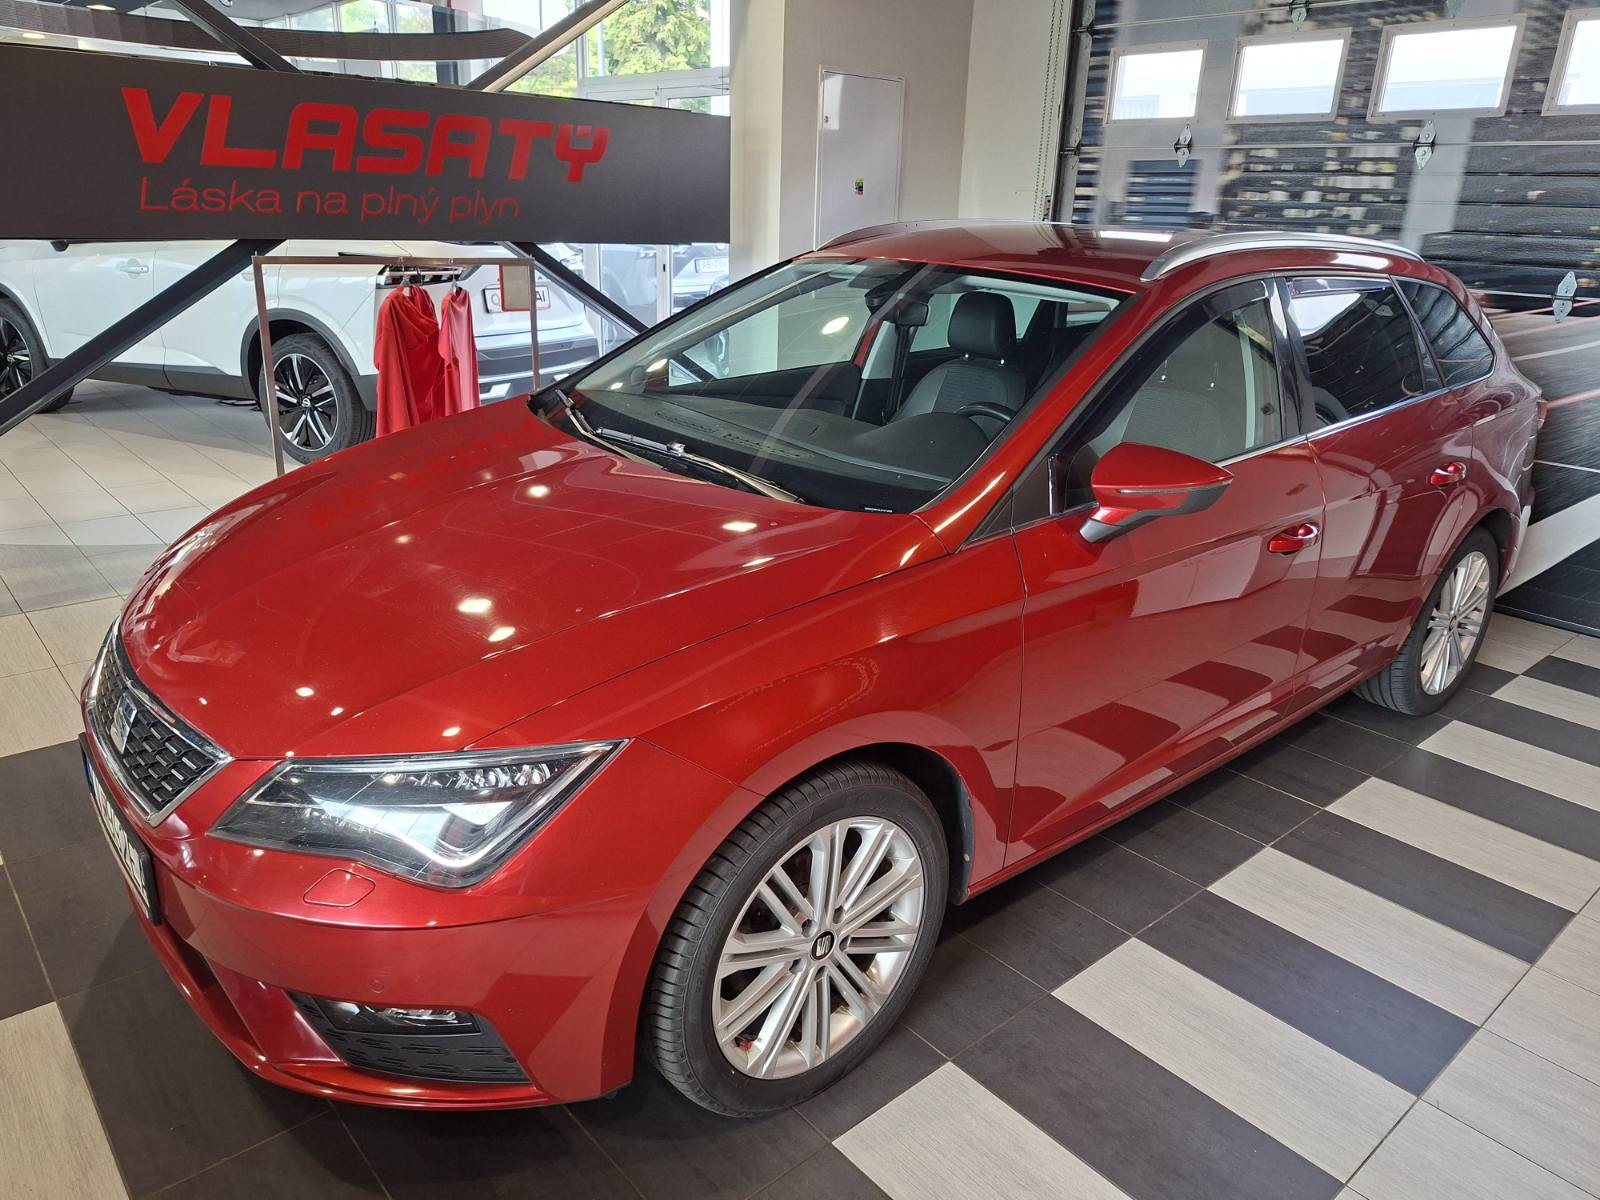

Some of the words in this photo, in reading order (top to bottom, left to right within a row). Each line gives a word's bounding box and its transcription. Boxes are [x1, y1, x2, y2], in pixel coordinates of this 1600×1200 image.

[139, 176, 283, 214] Láska
[295, 189, 350, 216] na
[360, 185, 441, 225] plný
[449, 189, 522, 225] plyn
